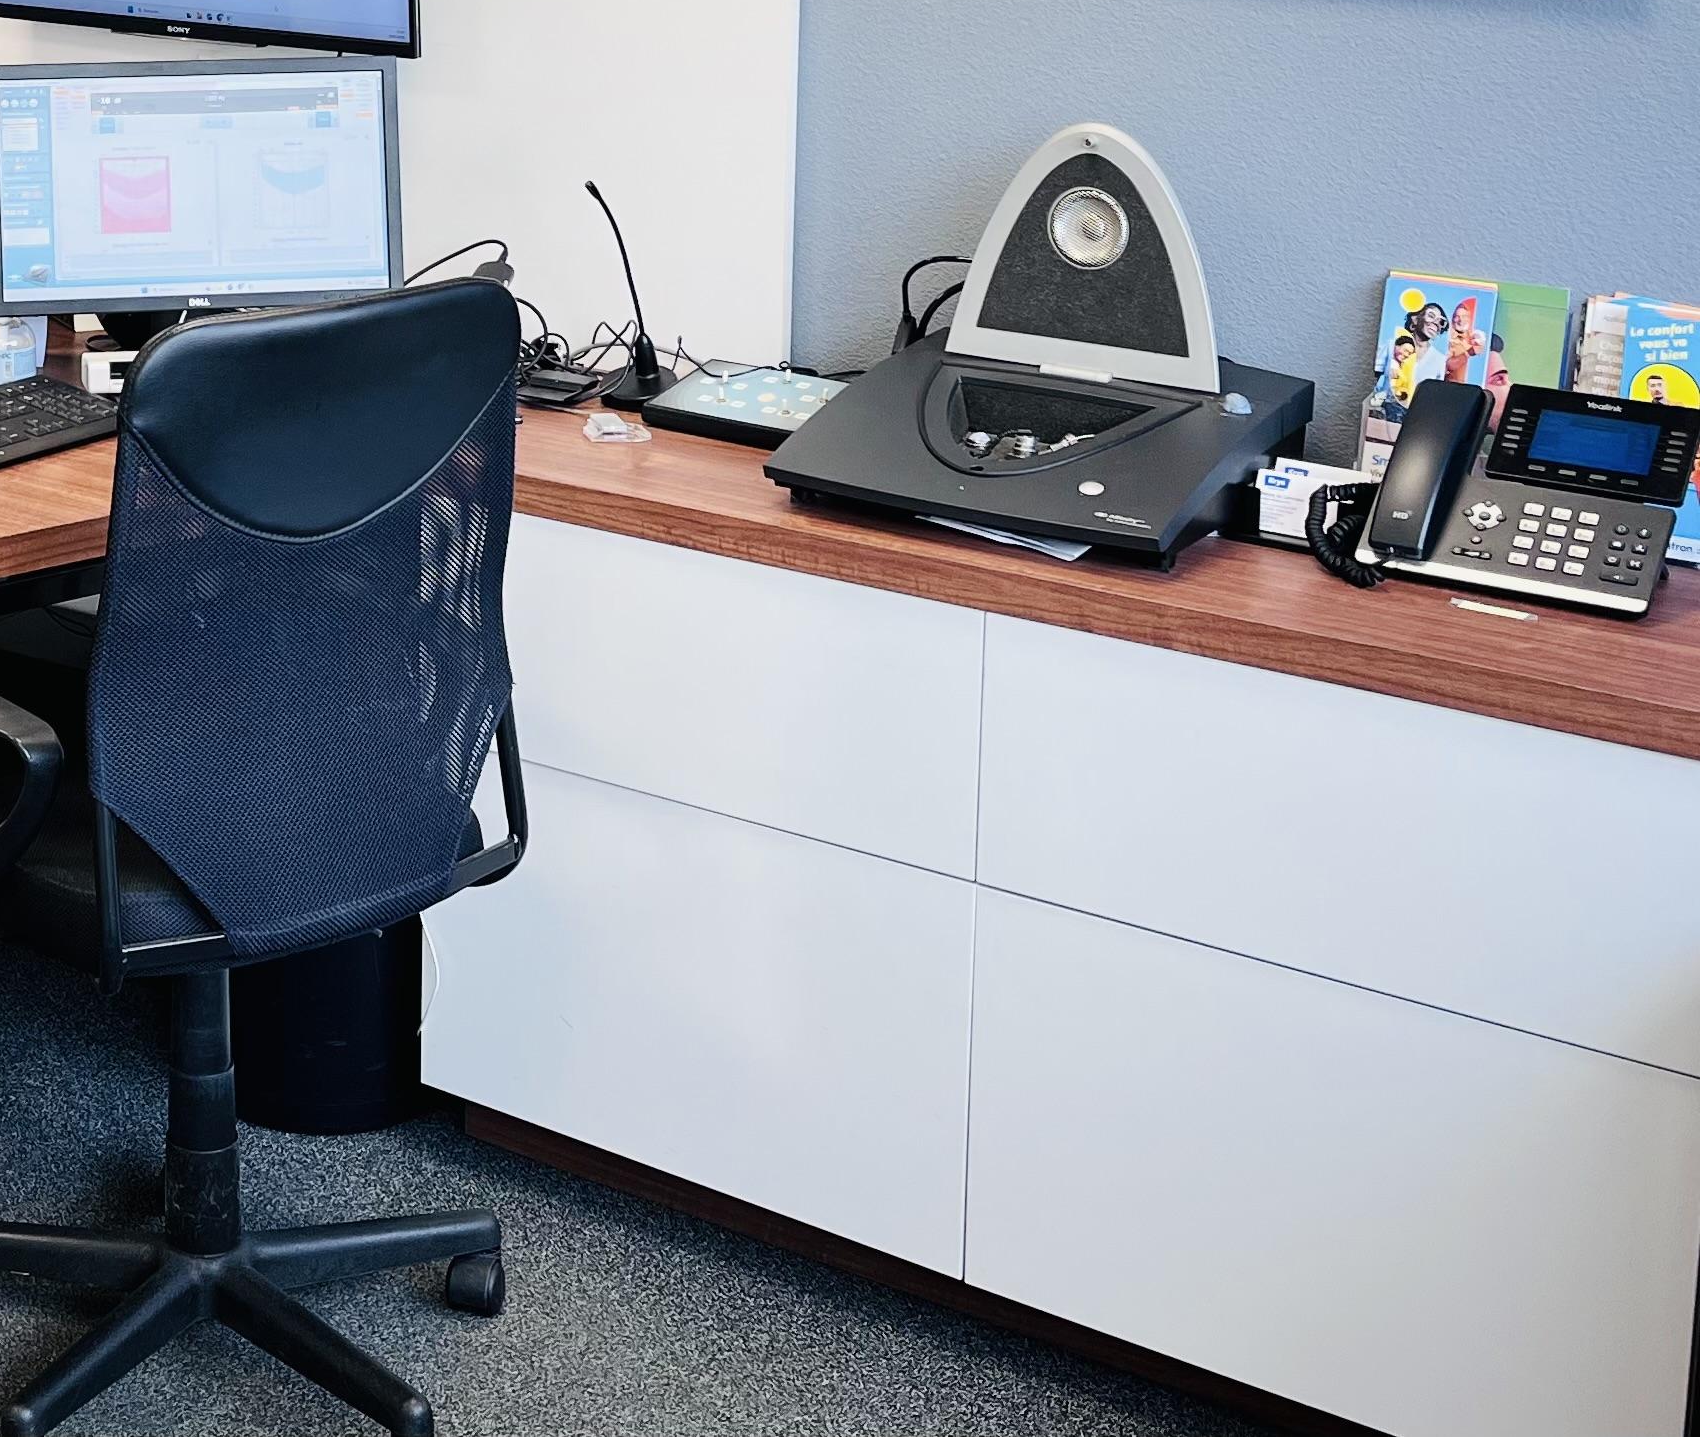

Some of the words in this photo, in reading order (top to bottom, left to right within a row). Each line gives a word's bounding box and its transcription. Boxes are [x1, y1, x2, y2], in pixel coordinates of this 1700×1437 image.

[166, 25, 191, 34] SONY
[188, 297, 212, 307] DELL
[1647, 322, 1695, 338] confort
[1644, 350, 1657, 362] si
[1659, 349, 1689, 361] bien
